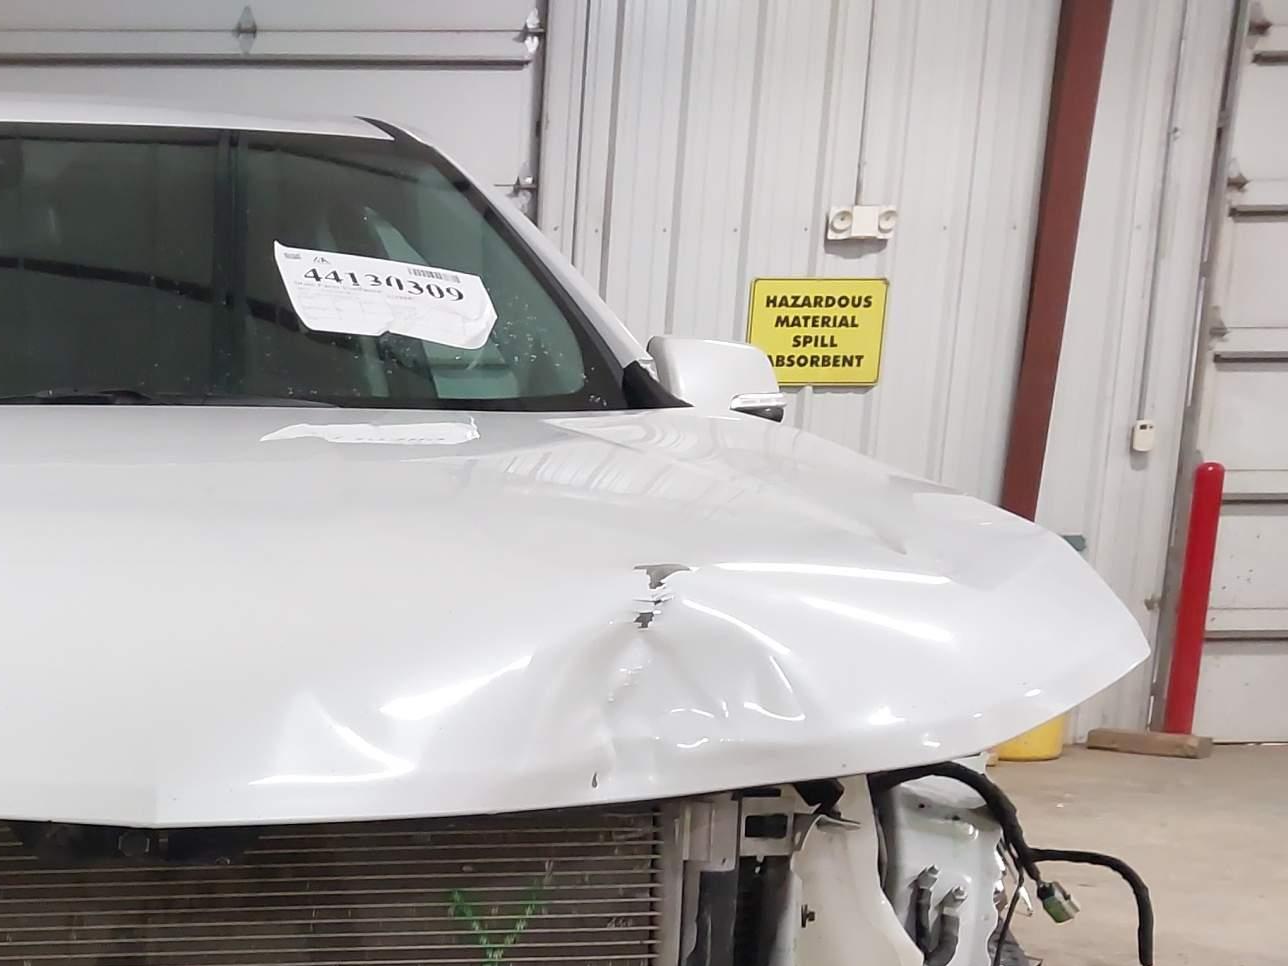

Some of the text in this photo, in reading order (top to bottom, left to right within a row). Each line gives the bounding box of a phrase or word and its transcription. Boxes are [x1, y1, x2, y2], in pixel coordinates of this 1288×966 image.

[303, 267, 465, 302] 44130309
[765, 295, 873, 308] HAZARDOUS
[774, 315, 859, 328] MATERIAL
[791, 335, 838, 348] SPILL
